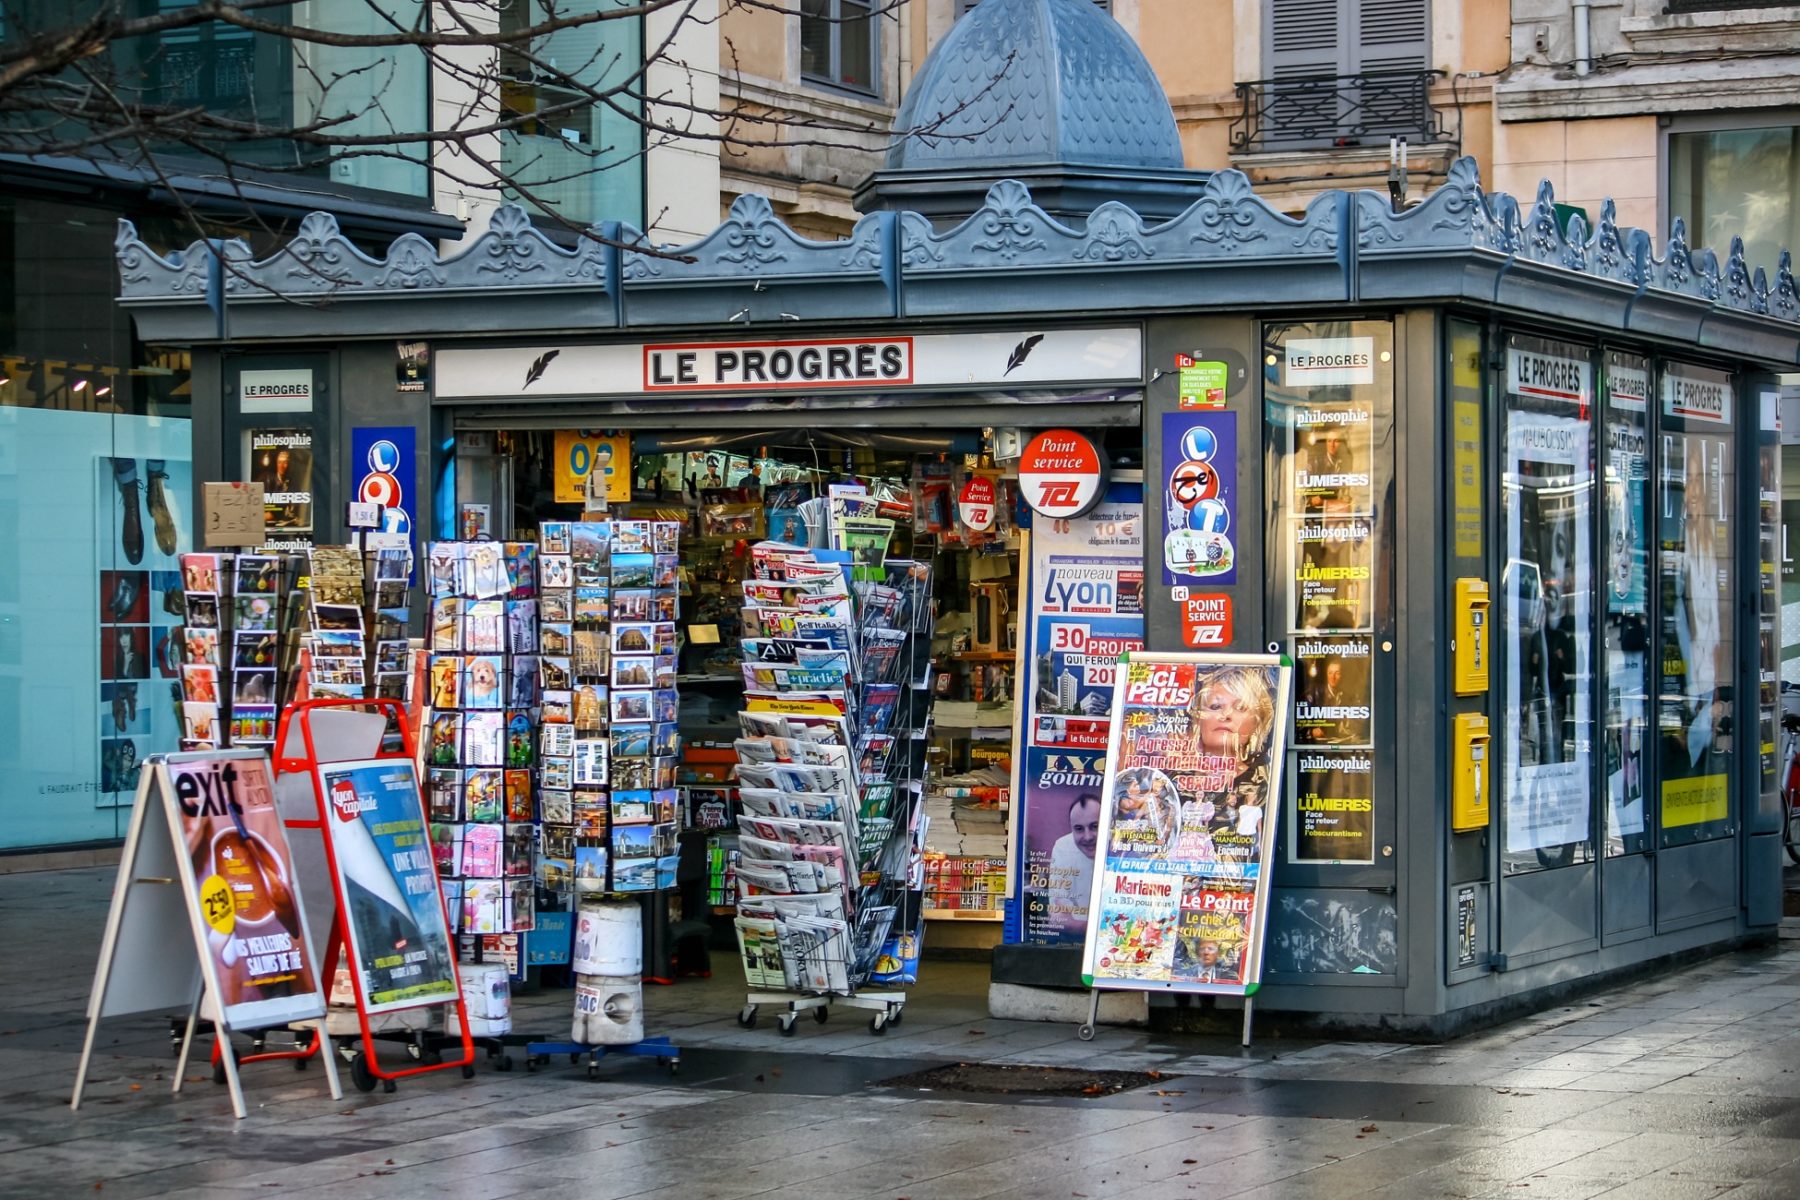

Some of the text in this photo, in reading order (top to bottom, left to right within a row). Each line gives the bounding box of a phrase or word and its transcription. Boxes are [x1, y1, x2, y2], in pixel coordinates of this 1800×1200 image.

[653, 352, 698, 385] LE
[1291, 357, 1304, 367] LE
[1518, 355, 1530, 383] LE
[245, 386, 256, 395] LE
[1611, 375, 1617, 393] LE
[1672, 380, 1681, 405] LE
[1296, 408, 1368, 427] philosophie
[253, 433, 311, 449] philosophie
[1040, 439, 1076, 452] Point
[1033, 455, 1083, 468] service
[1296, 473, 1369, 487] LUMIERES
[971, 483, 989, 492] Point
[1038, 481, 1080, 507] TCL
[265, 492, 311, 504] MIERES
[966, 492, 991, 502] Service
[969, 508, 988, 524] TCL
[1095, 522, 1133, 536] 10 €
[1297, 525, 1369, 543] philosophie
[1057, 568, 1113, 580] nouveau
[1296, 567, 1369, 581] LUMIERES
[1045, 569, 1112, 612] Lyon
[1174, 588, 1187, 599] ici
[1188, 600, 1225, 612] POINT
[1188, 612, 1225, 621] SERVICE
[1056, 627, 1084, 649] 30
[1192, 625, 1224, 644] TCL
[1089, 641, 1144, 655] PROJET
[1298, 641, 1369, 658] philosophie
[1066, 655, 1117, 666] QUI FERON
[1088, 668, 1116, 684] 201
[1127, 682, 1190, 705] Paris
[1156, 712, 1189, 726] Sophie
[1296, 706, 1370, 719] LUMIERES
[1147, 724, 1188, 734] DAVANT
[1070, 735, 1078, 743] le
[1079, 735, 1098, 744] futur
[971, 749, 1009, 761] Bourgogne
[1044, 755, 1104, 775] LY
[1299, 756, 1371, 773] philosophie
[1039, 772, 1104, 789] gourm
[47, 783, 83, 794] FAUDRAIT
[176, 763, 243, 818] exit
[331, 787, 355, 807] Lyon
[1298, 798, 1372, 811] LUMIERES
[1030, 864, 1080, 878] Christophe
[1030, 874, 1072, 890] Roure
[1115, 876, 1172, 897] Marianne
[1029, 901, 1088, 915] 60 nouvea
[1119, 897, 1135, 905] BD
[1182, 894, 1250, 911] Le Point
